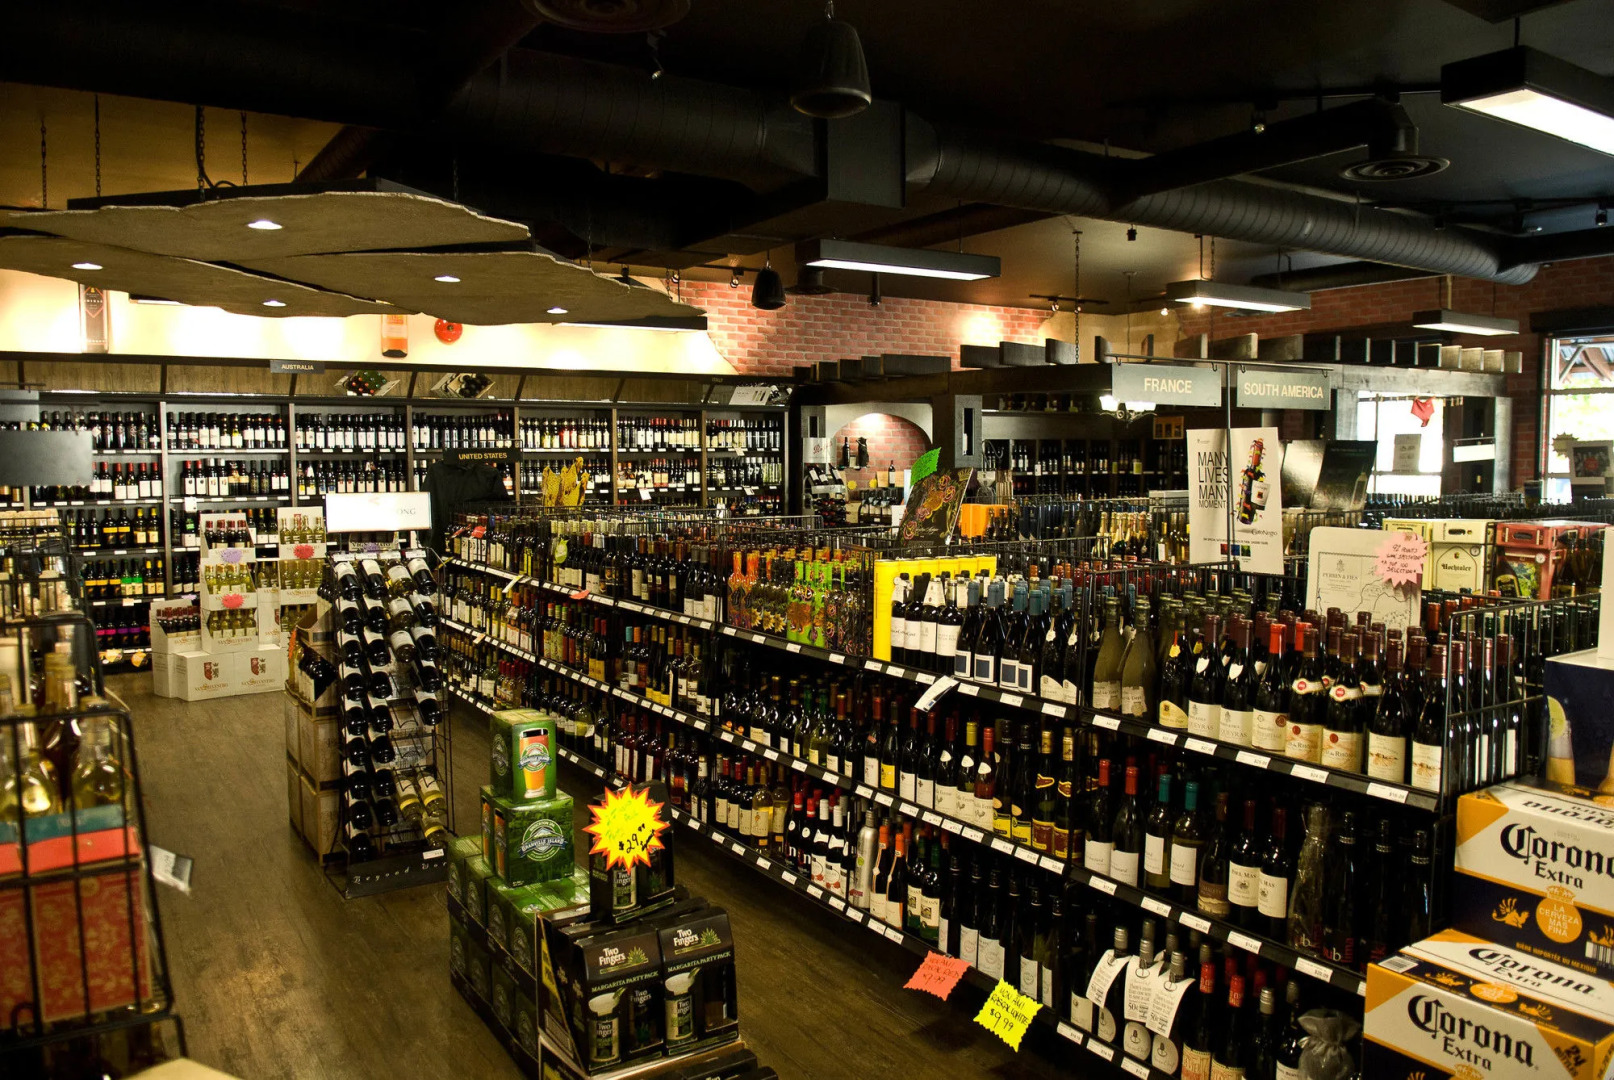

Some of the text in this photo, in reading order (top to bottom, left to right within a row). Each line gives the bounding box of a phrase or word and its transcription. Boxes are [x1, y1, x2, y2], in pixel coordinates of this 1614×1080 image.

[1144, 377, 1192, 394] FRANCE
[1244, 382, 1324, 399] SOUTH AMERICA
[458, 452, 482, 460] UNITED
[1198, 467, 1228, 483] LIVES
[1199, 500, 1228, 509] MOMENT
[521, 837, 565, 851] GRANVILLE ISLAND
[1535, 860, 1583, 889] Extra
[1539, 907, 1580, 926] CERVEZA
[1553, 904, 1565, 913] LA
[677, 928, 692, 937] Two
[1548, 926, 1568, 937] FINA
[1549, 919, 1568, 930] MAS
[673, 933, 699, 947] Fingers
[598, 952, 626, 966] Fingers
[603, 947, 619, 956] Two
[667, 951, 731, 972] MARGARITA PARTY PACK
[1571, 958, 1598, 974] MEXIQUE
[1468, 948, 1595, 995] Corona
[1493, 966, 1542, 988] Extra
[591, 970, 659, 992] MARGARITA PARTY PACK
[1407, 994, 1535, 1067] Corona
[1443, 1036, 1492, 1071] Extra
[1566, 1044, 1587, 1066] 24
